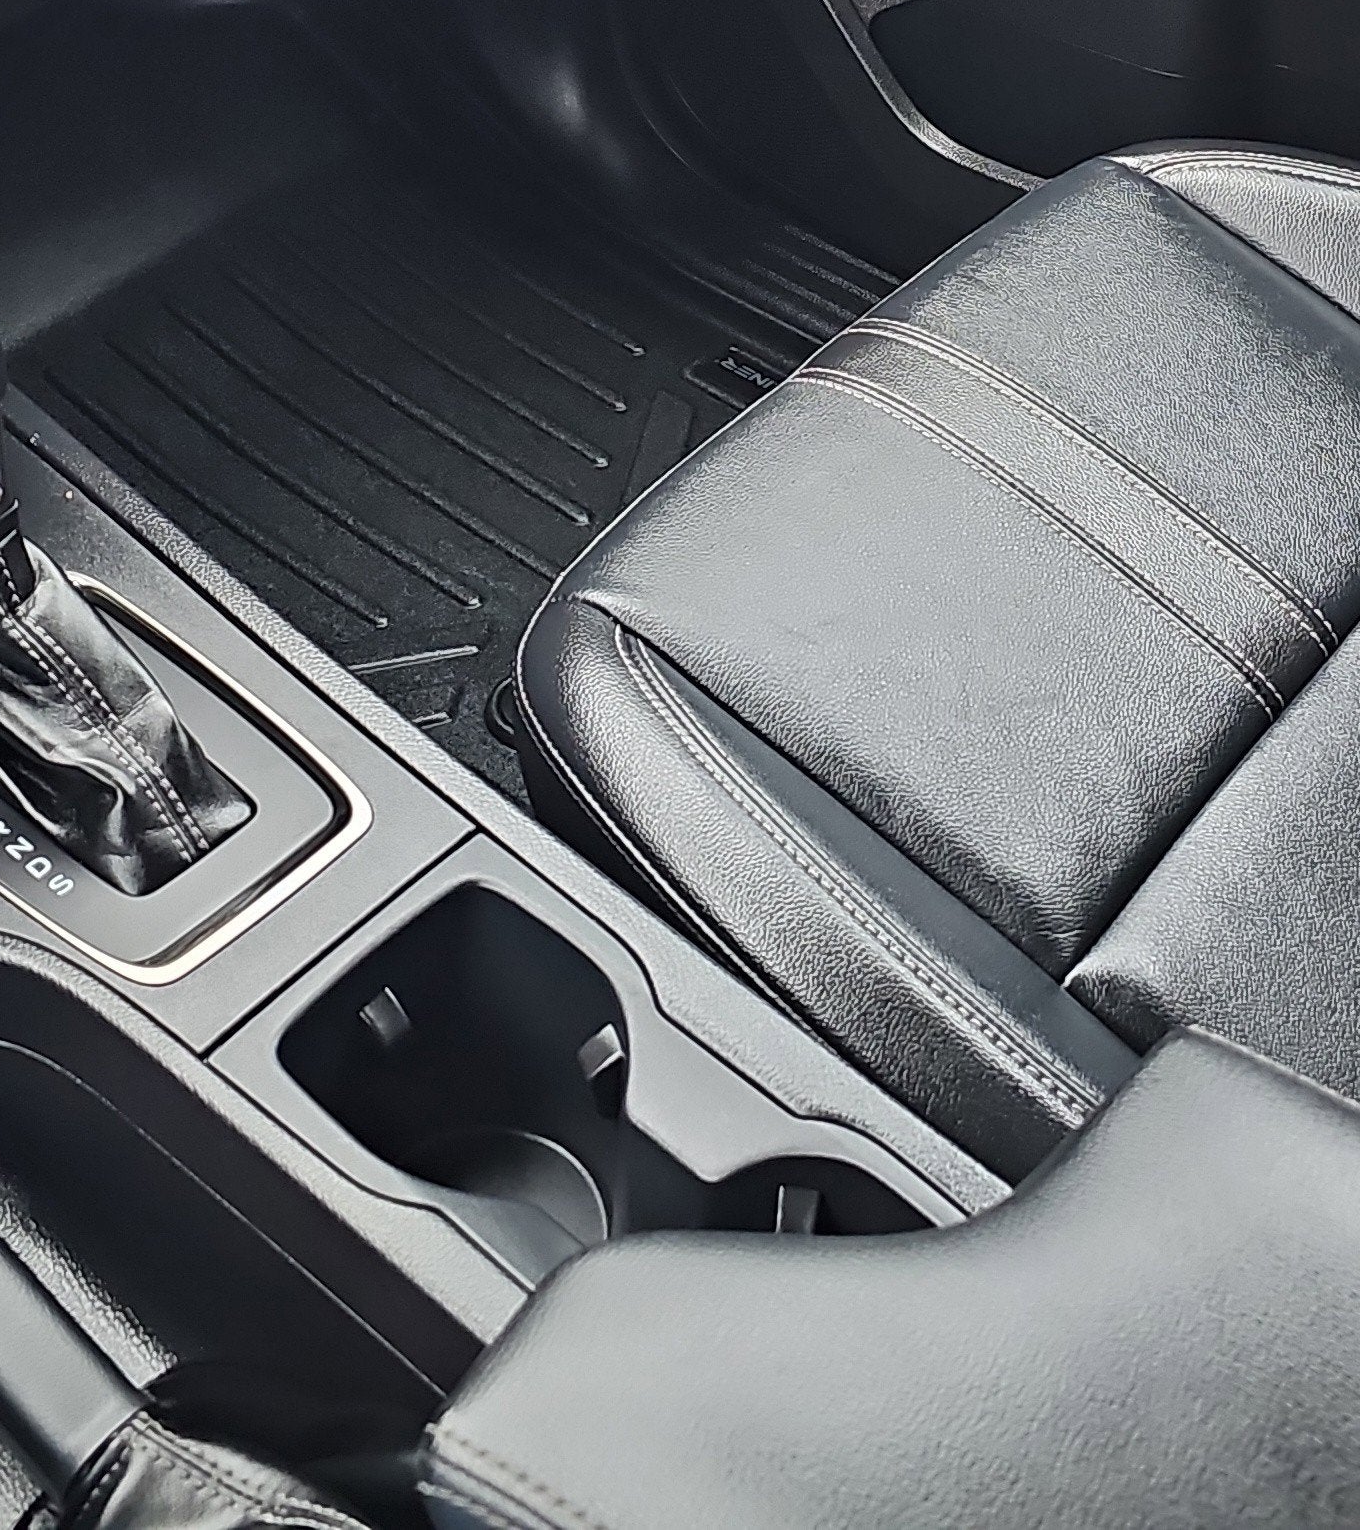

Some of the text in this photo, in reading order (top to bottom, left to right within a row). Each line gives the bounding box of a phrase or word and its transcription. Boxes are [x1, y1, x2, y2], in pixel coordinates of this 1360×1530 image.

[5, 836, 34, 860] N
[24, 856, 53, 880] D
[47, 874, 75, 897] S
